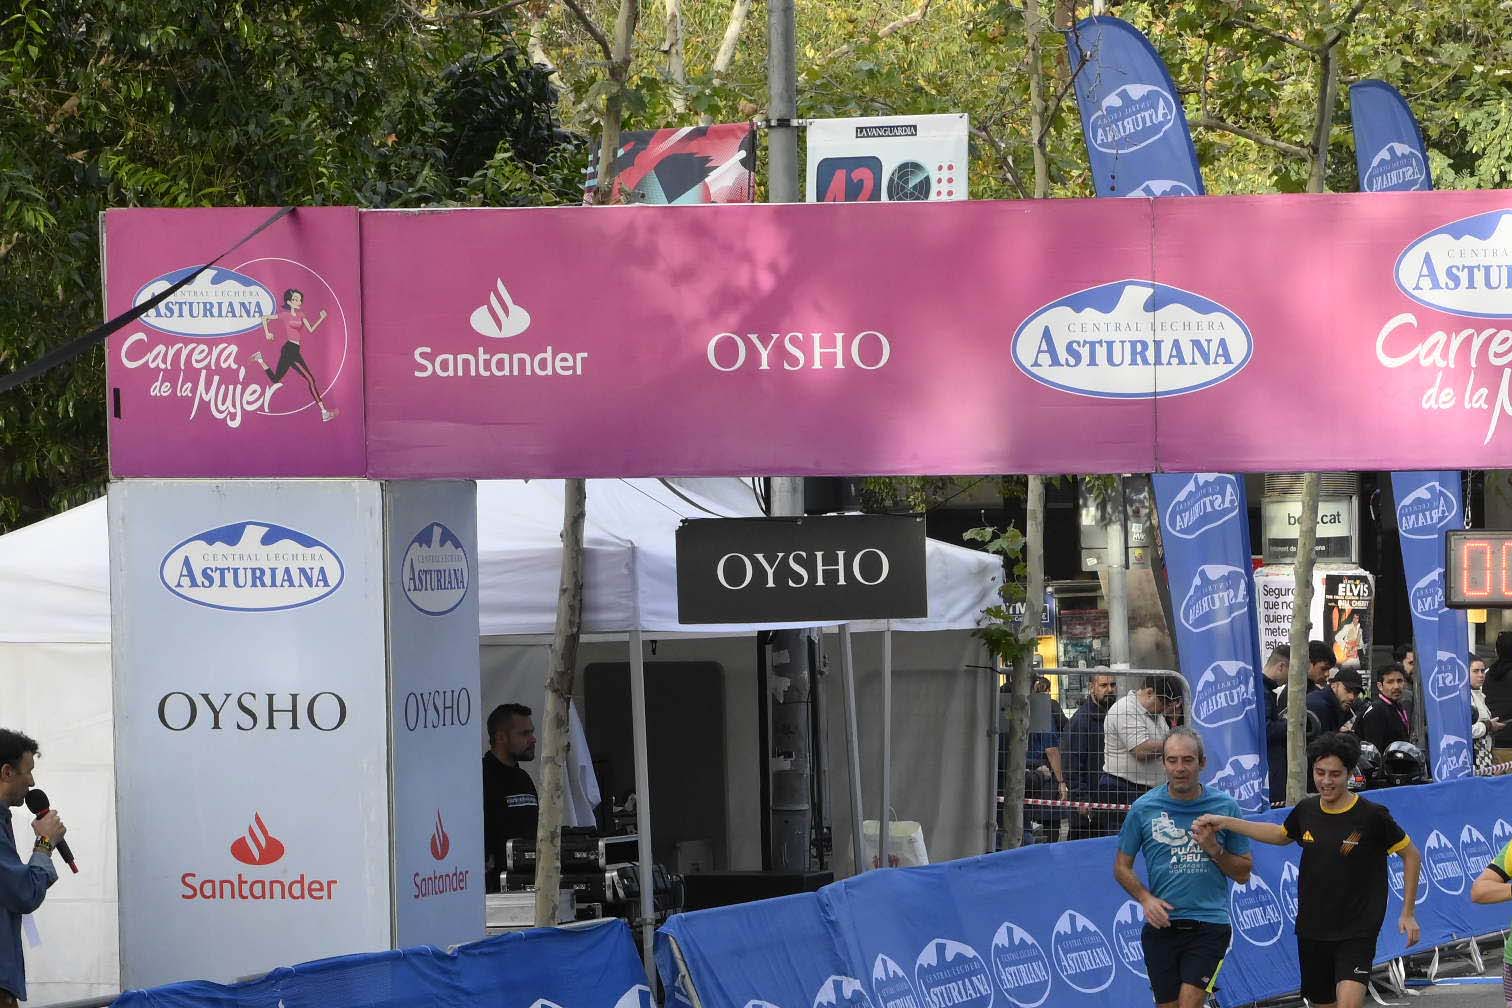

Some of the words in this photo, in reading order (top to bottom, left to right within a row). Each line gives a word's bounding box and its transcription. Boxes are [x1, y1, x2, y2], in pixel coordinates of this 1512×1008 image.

[866, 126, 916, 137] VANGUARDIA
[144, 291, 264, 319] ASTURIANA
[1067, 322, 1143, 333] CENTRAL
[1152, 320, 1226, 332] LECHERA
[120, 332, 239, 369] Carrera
[414, 345, 588, 378] Santander
[706, 330, 891, 372] OYSHO
[1030, 325, 1235, 370] ASTURIANA
[150, 371, 171, 398] de
[176, 373, 192, 397] la
[189, 364, 284, 428] Mujer
[1421, 372, 1455, 410] de
[1462, 374, 1488, 410] la
[175, 555, 331, 589] ASTURIANA
[203, 553, 261, 562] CENTRAL
[264, 553, 325, 562] LECHERA
[716, 548, 890, 591] OYSHO
[407, 557, 466, 592] ASTURIANA
[1338, 583, 1369, 597] ELVIS
[1264, 602, 1280, 614] que
[1264, 611, 1295, 627] quiere
[157, 691, 347, 732] OYSHO
[404, 687, 471, 732] OYSHO
[1180, 853, 1201, 863] PEU
[181, 872, 338, 901] Santander
[413, 865, 469, 899] Santander
[1058, 944, 1113, 976] ASTURIANA
